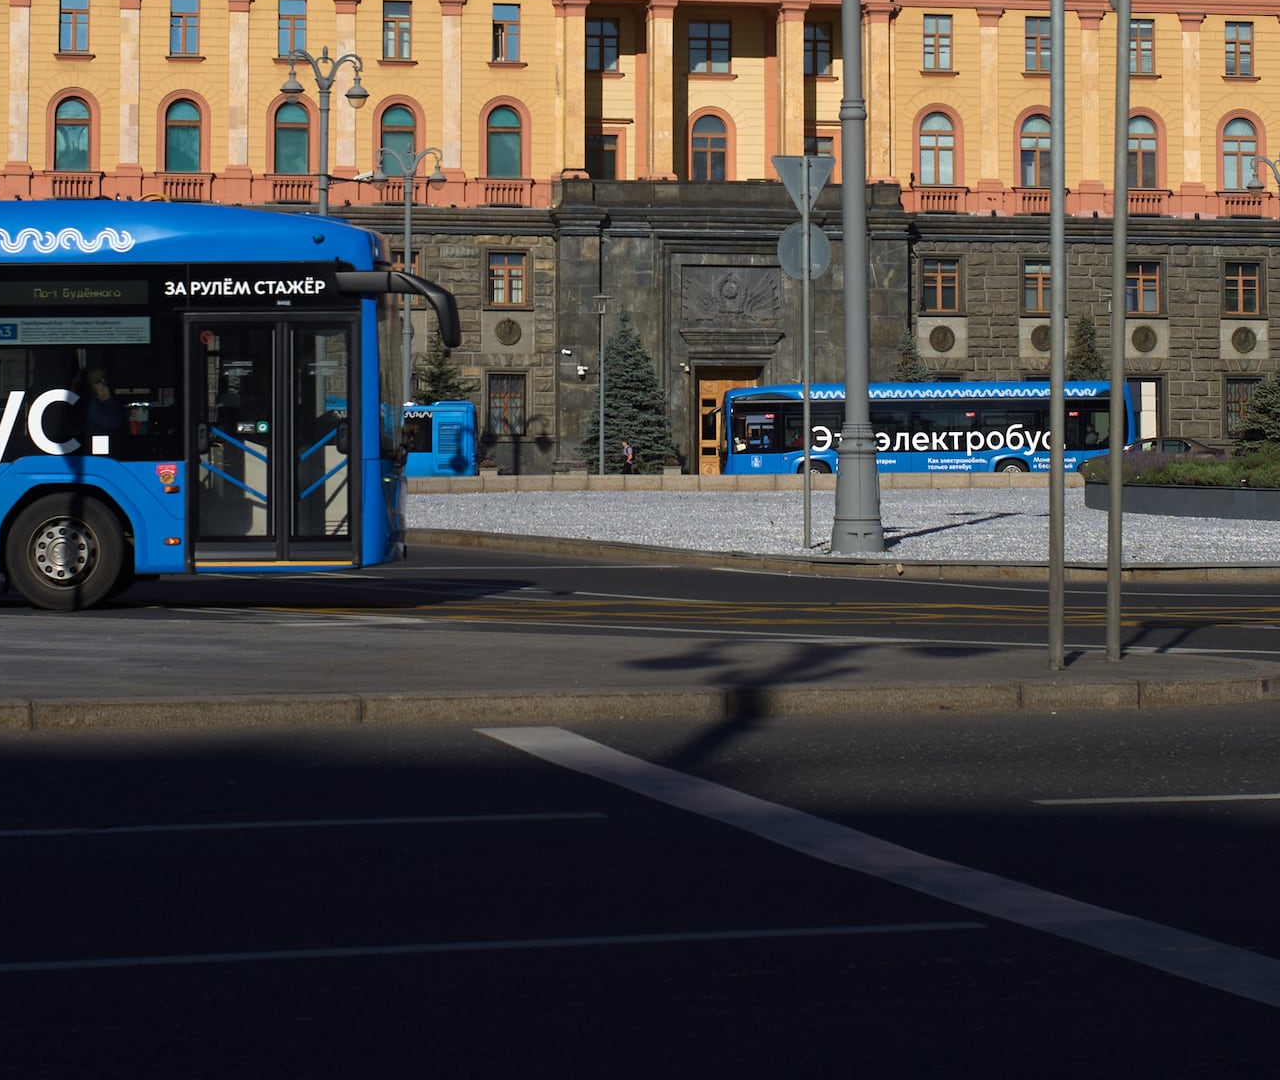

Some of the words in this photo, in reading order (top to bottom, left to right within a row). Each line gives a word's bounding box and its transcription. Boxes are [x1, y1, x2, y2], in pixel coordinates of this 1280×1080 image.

[164, 281, 187, 295] ЗА
[190, 278, 252, 295] РУЛЁМ
[254, 277, 326, 295] СТАЖЁР
